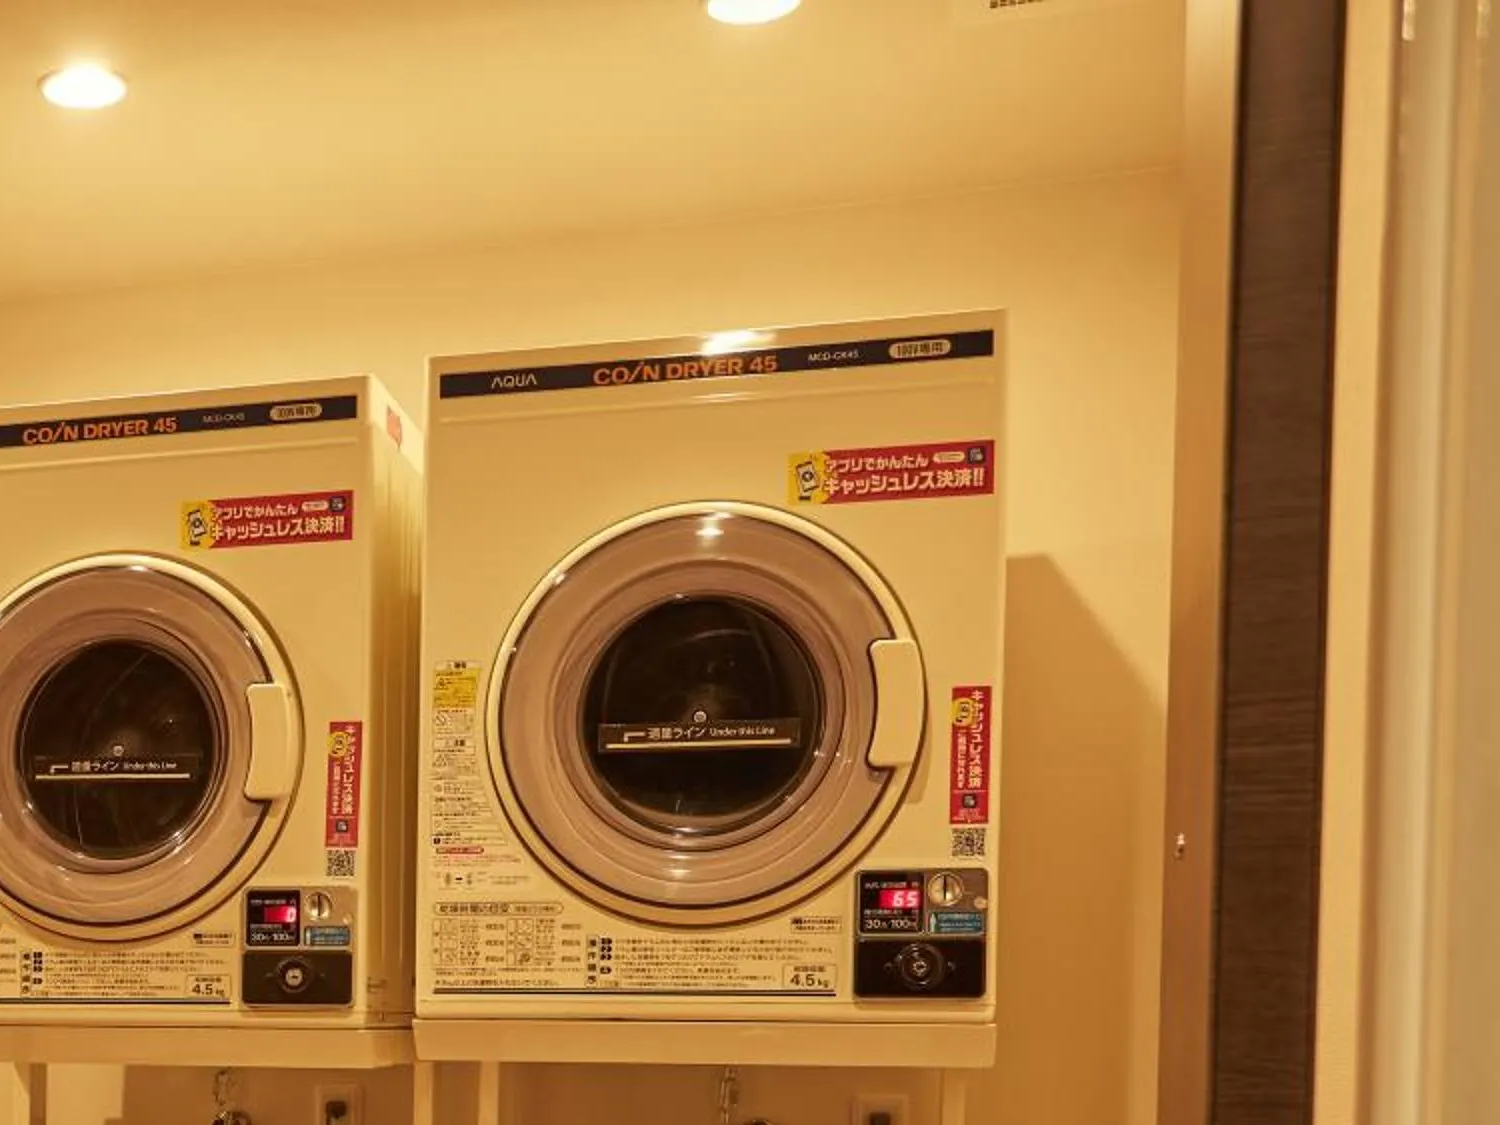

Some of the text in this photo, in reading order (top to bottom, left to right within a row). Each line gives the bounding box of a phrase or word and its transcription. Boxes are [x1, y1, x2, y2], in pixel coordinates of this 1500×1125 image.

[491, 374, 537, 389] AQUA
[666, 357, 743, 380] DRYER
[750, 355, 777, 373] 45
[83, 419, 149, 440] DRYER
[154, 417, 177, 433] 45
[825, 453, 929, 473] アプリでかんたん
[211, 503, 298, 520] アプリでかんたん
[893, 890, 917, 908] 65
